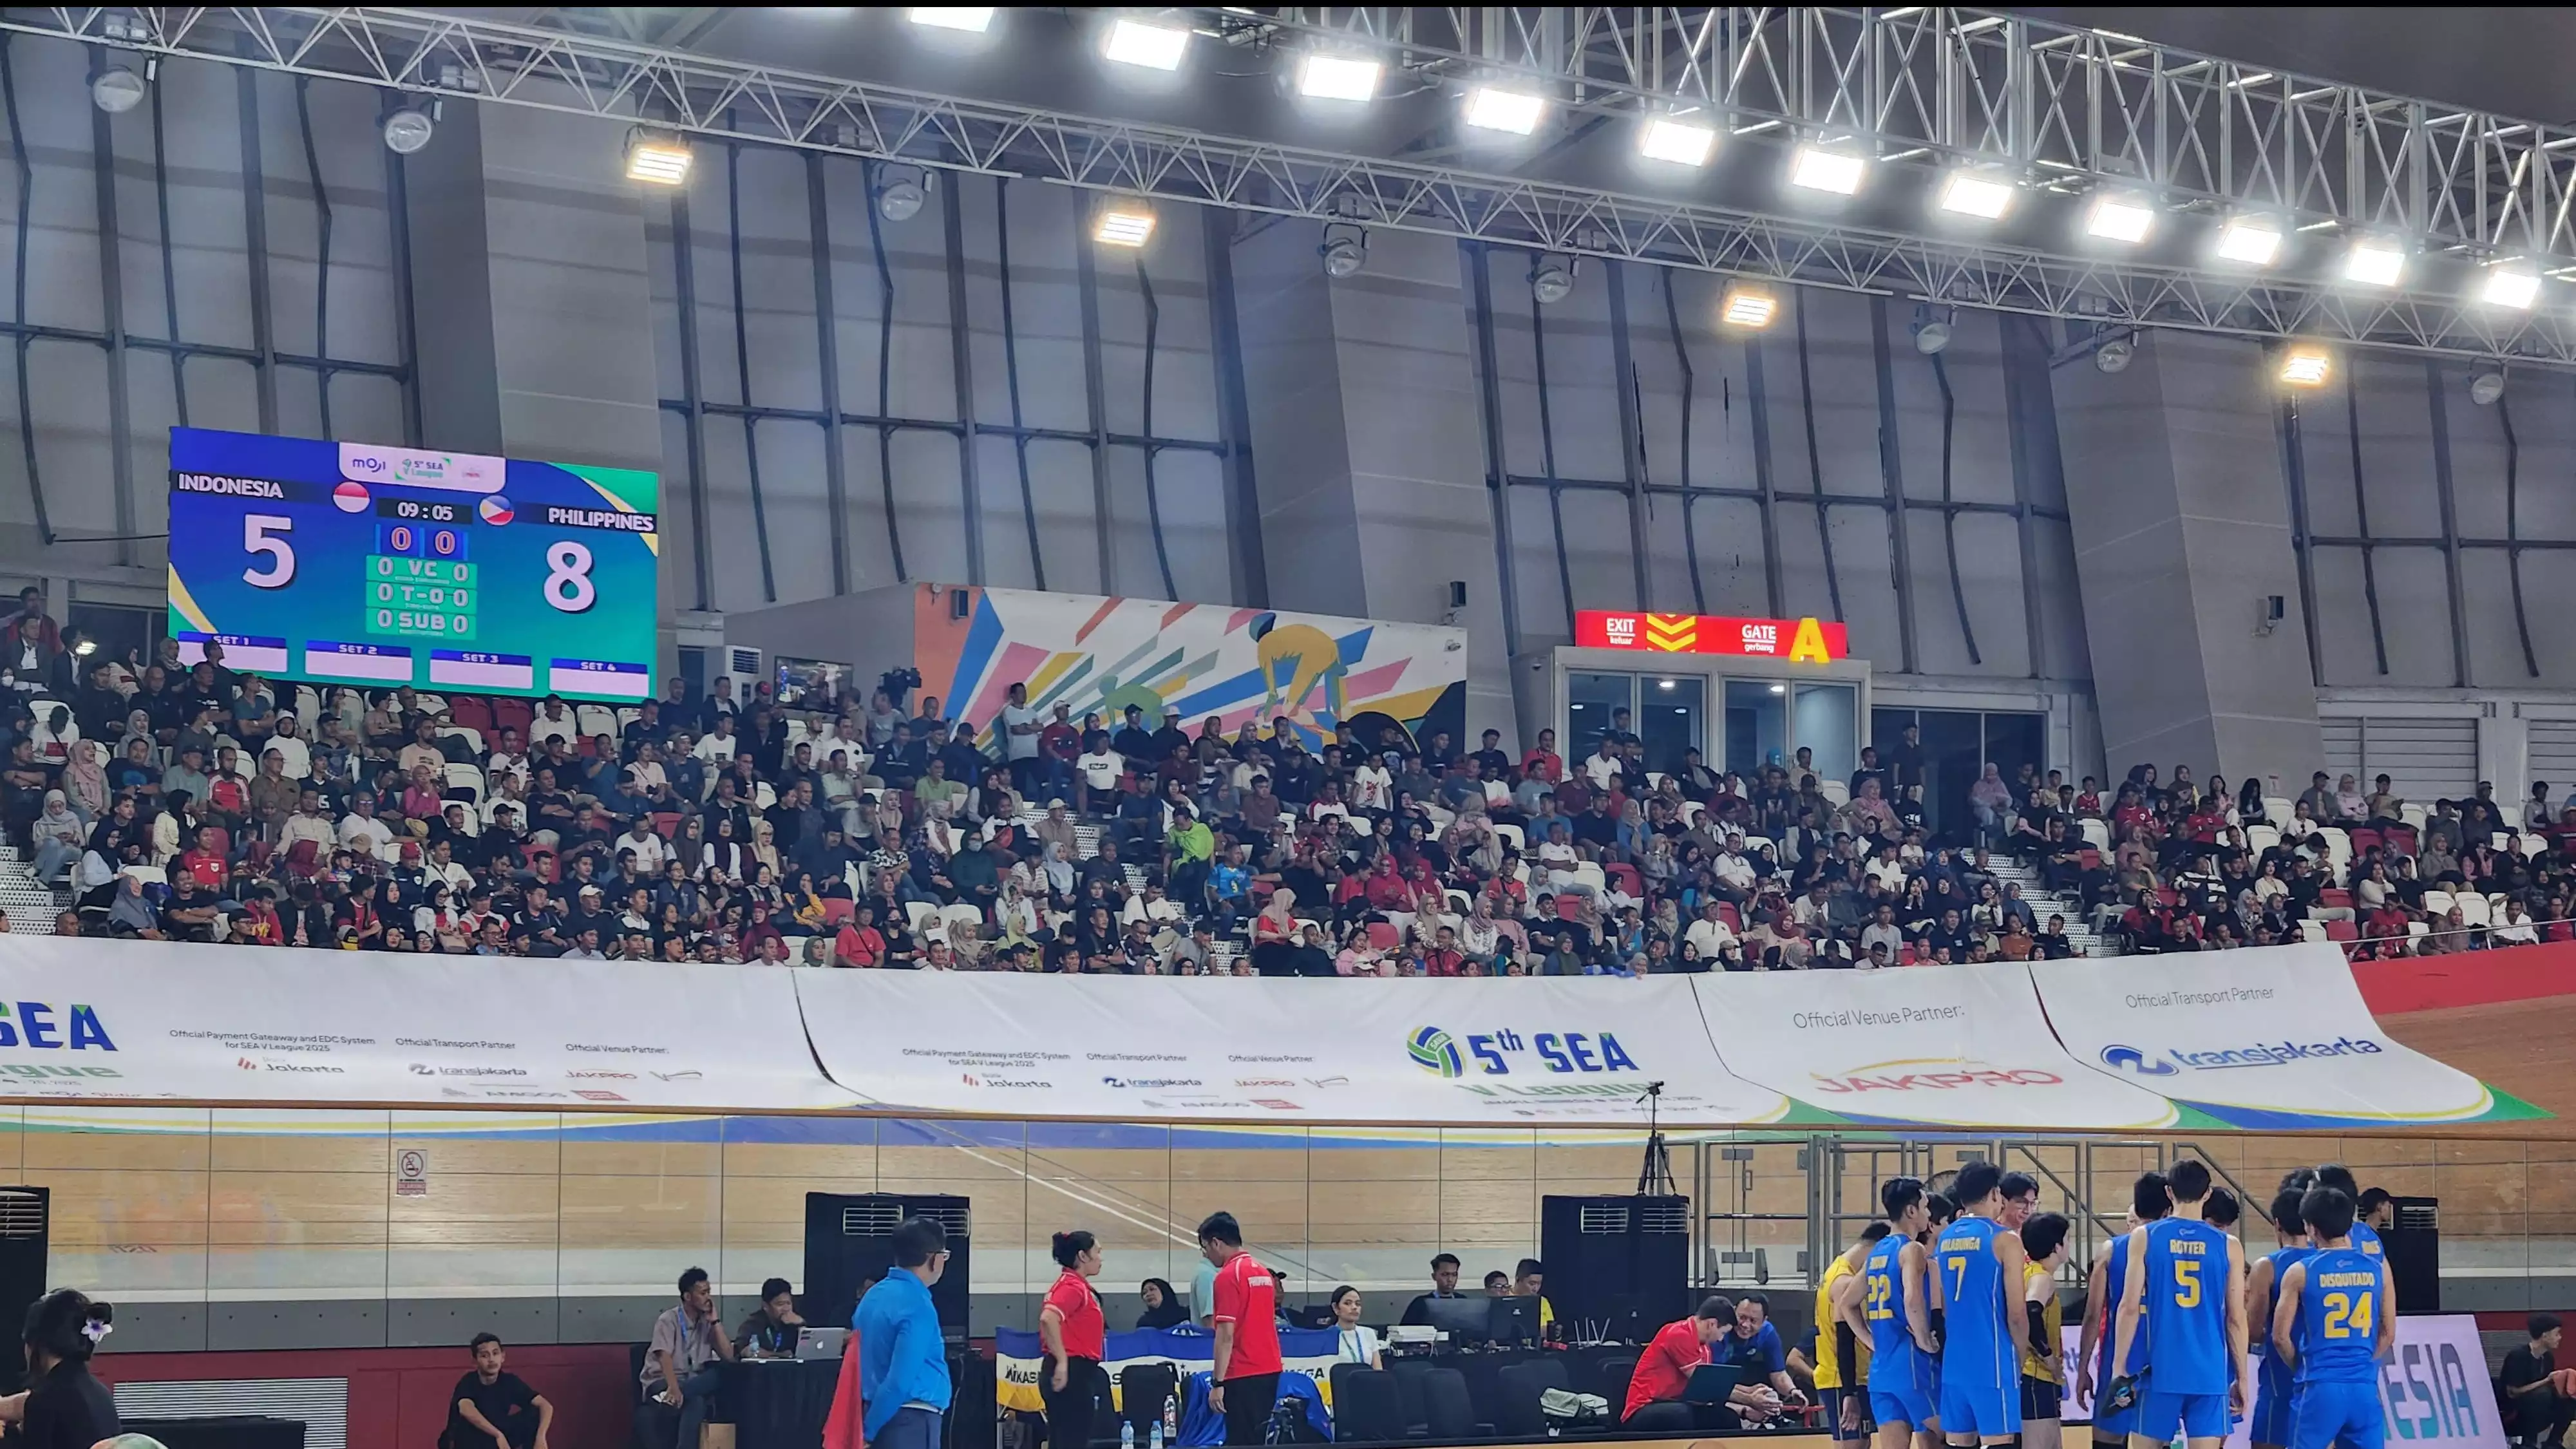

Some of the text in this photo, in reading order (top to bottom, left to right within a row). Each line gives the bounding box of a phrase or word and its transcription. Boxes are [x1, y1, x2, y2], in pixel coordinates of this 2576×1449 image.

[426, 462, 444, 471] SEA
[178, 473, 284, 498] INDONESIA
[548, 507, 654, 532] PHILIPPINES
[391, 527, 455, 554] 0 0
[242, 513, 296, 587] 5
[377, 556, 394, 576] 0
[408, 560, 438, 577] VC
[453, 564, 469, 582] 0
[542, 541, 596, 612] 8
[377, 583, 393, 602] 0
[453, 589, 469, 607] 0
[377, 609, 469, 634] 0 SUB 0
[1606, 618, 1636, 634] EXIT
[213, 635, 249, 646] SET 1
[1609, 636, 1633, 645] keluar
[1742, 624, 1776, 641] GATE
[1788, 617, 1830, 664] A
[339, 644, 378, 655] SET 2
[1744, 643, 1774, 654] gerbang
[462, 653, 500, 664] SET 3
[580, 661, 616, 672] SET 4
[2126, 987, 2274, 1009] Official Transport Partner
[1793, 1004, 1965, 1030] Official Venue Partner:
[169, 1029, 205, 1038] Official
[207, 1031, 248, 1042] Payment
[340, 1036, 376, 1045] System
[395, 1038, 516, 1049] Official Transport Partner
[269, 1043, 305, 1052] League
[565, 1043, 600, 1052] Official
[601, 1045, 631, 1053] Venue
[902, 1048, 931, 1056] Official
[933, 1049, 967, 1058] Payment
[1041, 1052, 1071, 1061] System
[1466, 1028, 1641, 1074] 5th SEA
[2168, 1036, 2383, 1068] transjakarta
[1118, 1054, 1156, 1063] Transport
[1228, 1054, 1258, 1063] Official
[0, 1065, 124, 1078] gue
[263, 1063, 345, 1074] Jakarta
[565, 1069, 638, 1079] JAKPRO
[986, 1079, 1053, 1088] Jakarta
[1234, 1078, 1296, 1087] JAKPRO
[1816, 1069, 2064, 1094] JAKPRO
[1947, 1256, 1967, 1302] 7
[2174, 1260, 2201, 1309] 5
[2318, 1272, 2375, 1288] DISQUITADO
[1867, 1274, 1893, 1320] 22
[2323, 1291, 2372, 1339] 24
[1005, 1364, 1041, 1384] MIKAS
[2383, 1342, 2481, 1441] ESIA
